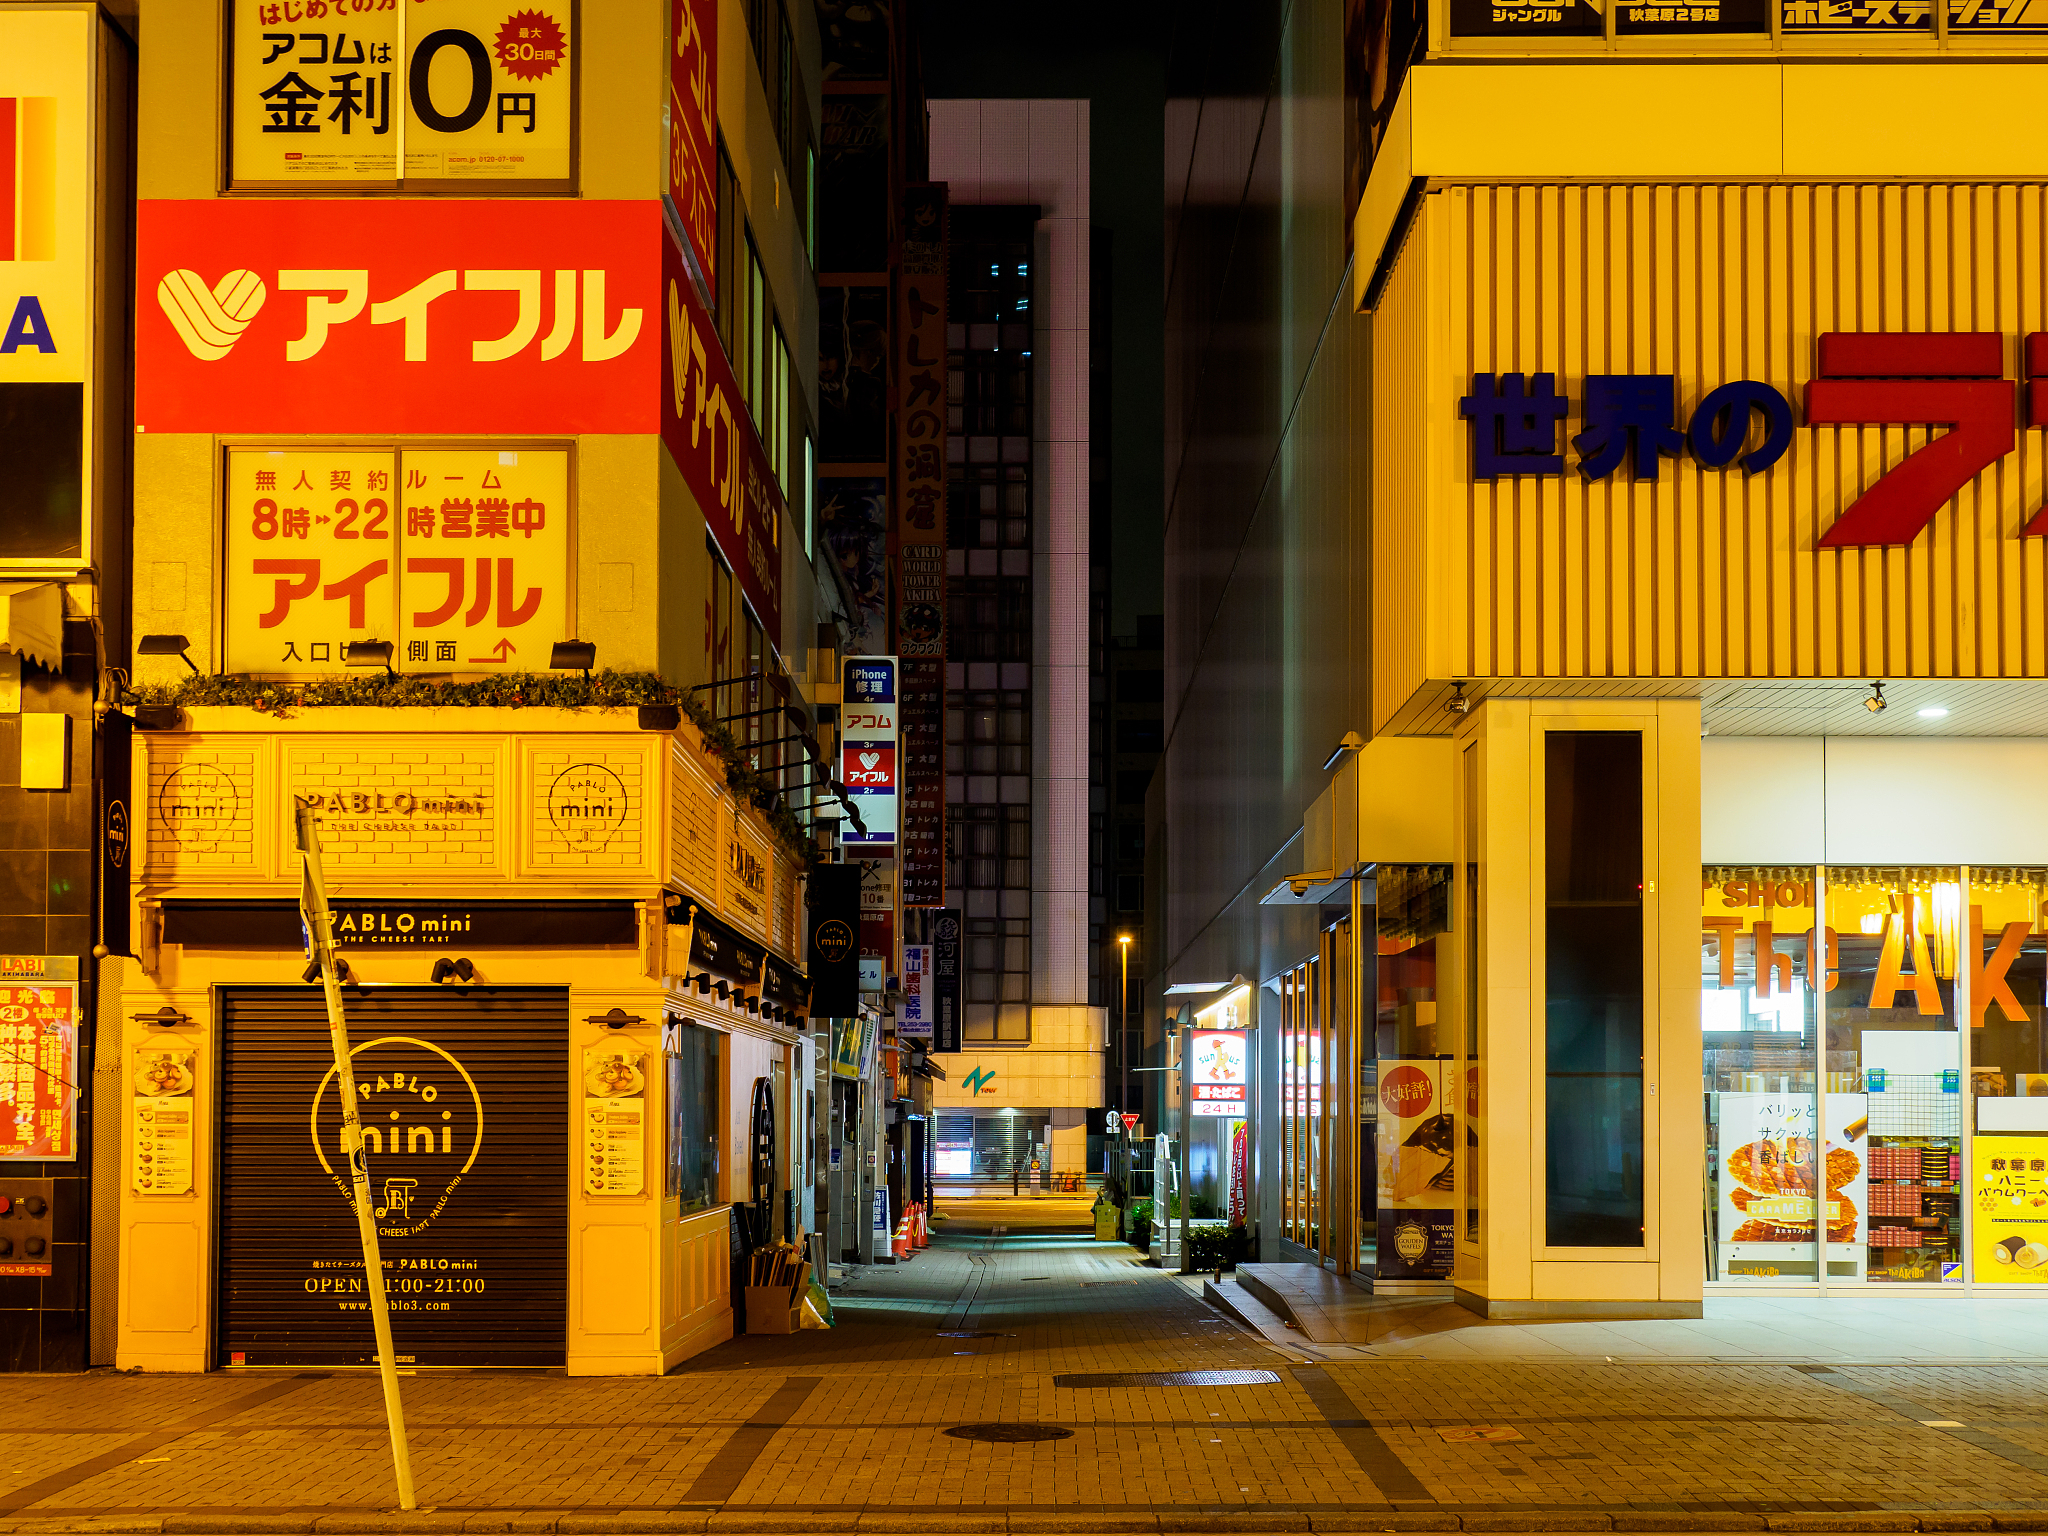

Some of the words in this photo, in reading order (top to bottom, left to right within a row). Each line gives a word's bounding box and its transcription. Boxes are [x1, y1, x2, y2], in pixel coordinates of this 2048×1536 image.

[1492, 8, 1562, 22] ジャングル
[1629, 8, 1720, 22] 秋葉原2号店
[518, 27, 542, 39] 最大
[262, 33, 392, 65] アコムは
[504, 43, 556, 61] 30日間
[278, 269, 643, 362] アイフル
[691, 321, 744, 536] アイフル
[255, 469, 502, 492] 無人契約ルーム
[251, 497, 311, 541] 8時
[334, 497, 546, 540] 22時営業中
[902, 545, 942, 559] CARD
[902, 560, 942, 573] WORLD
[902, 574, 942, 587] TOWER
[253, 557, 542, 629] アイフル
[903, 588, 943, 601] AKIBA
[851, 668, 887, 680] iPhone
[903, 663, 914, 671] 7F
[856, 681, 883, 693] 修理
[902, 694, 914, 702] 6F
[847, 714, 892, 729] アコム
[905, 755, 914, 764] F
[850, 771, 889, 783] アイフル
[570, 779, 606, 793] PABLO
[304, 791, 413, 815] PABLO
[422, 792, 483, 815] mini
[561, 797, 613, 817] mini
[421, 913, 471, 932] mini
[343, 935, 364, 943] THE
[371, 935, 415, 943] CHEESE
[422, 935, 450, 943] TART
[821, 935, 847, 946] mini
[936, 918, 959, 976] 駿河屋
[2, 958, 45, 971] LABI
[359, 1073, 438, 1103] PABLO
[1382, 1080, 1432, 1104] 大好評!
[339, 1110, 452, 1153] mini
[1758, 1126, 1816, 1141] サクッと
[1990, 1158, 2046, 1172] 秋葉原
[1999, 1174, 2041, 1186] ハニー
[1779, 1187, 1807, 1196] TOKYO
[331, 1175, 352, 1199] PABLO
[379, 1227, 409, 1236] CHEESE
[430, 1195, 449, 1220] PABLO
[445, 1175, 462, 1194] mini
[400, 1258, 449, 1270] PABLO
[451, 1259, 478, 1270] mini
[304, 1278, 362, 1293] OPEN
[384, 1278, 485, 1293] 1:00-21:00
